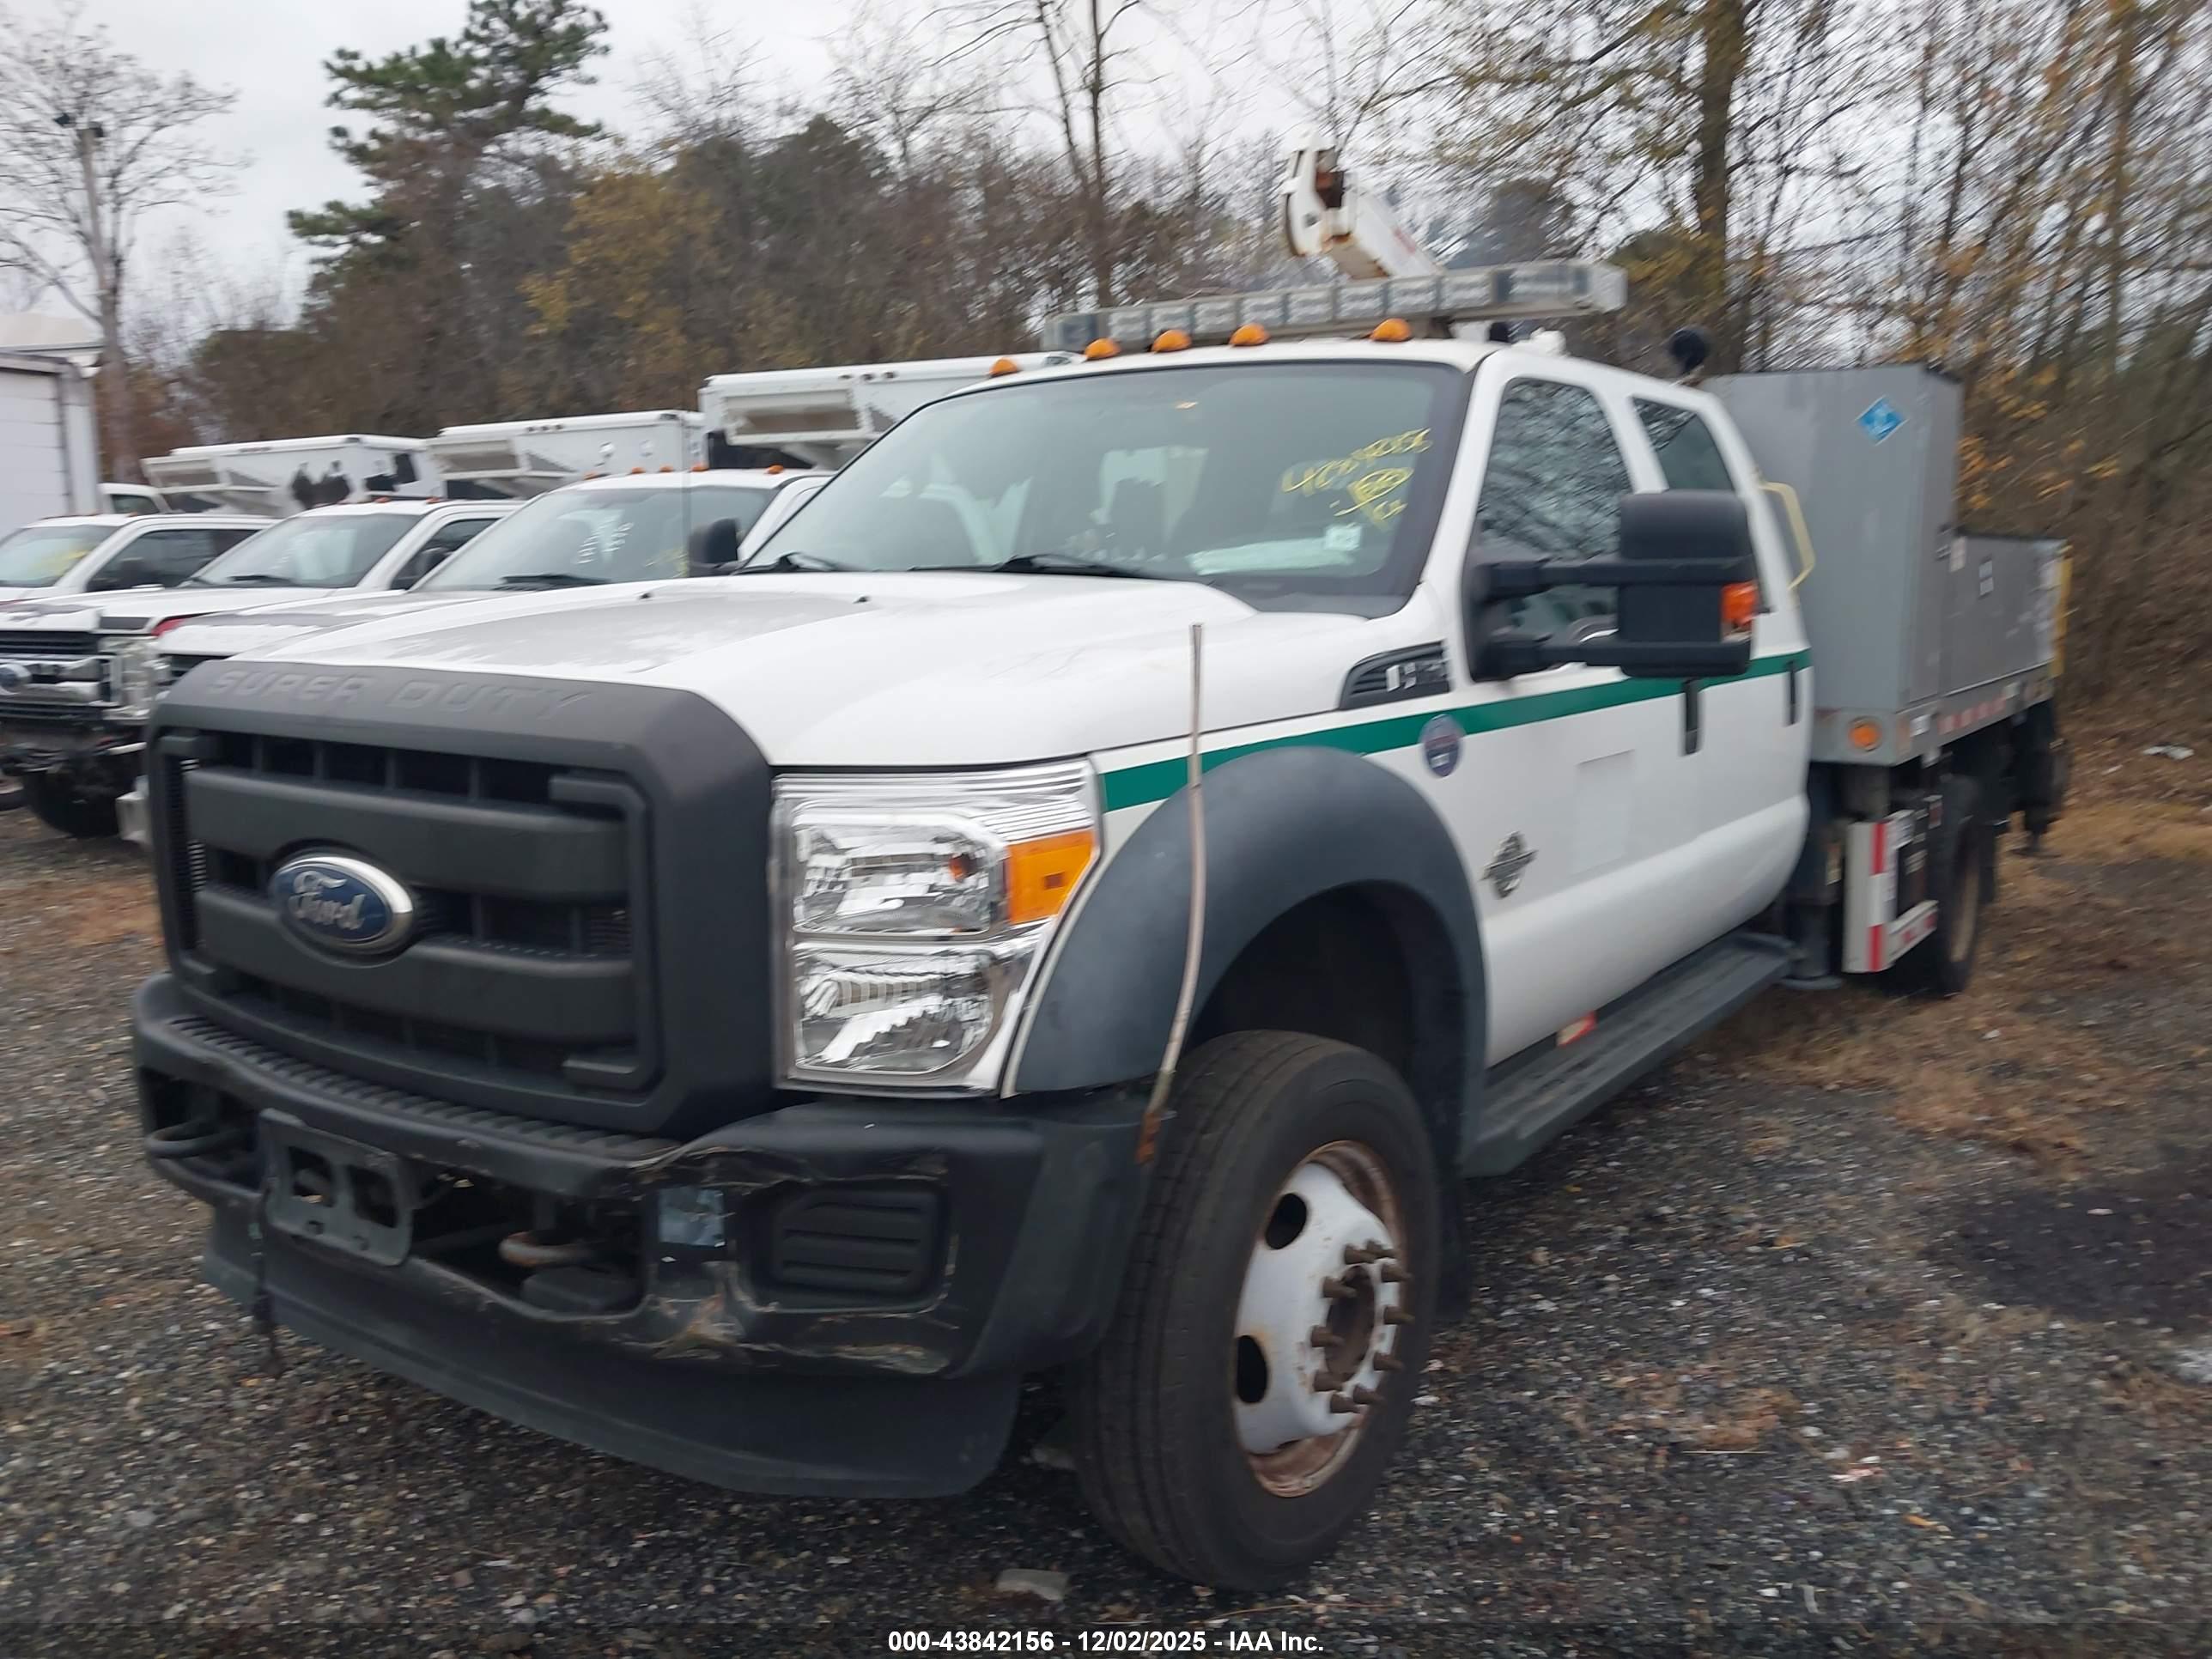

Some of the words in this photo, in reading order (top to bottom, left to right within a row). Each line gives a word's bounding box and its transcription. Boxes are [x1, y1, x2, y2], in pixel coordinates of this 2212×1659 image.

[209, 668, 377, 703] SUPER
[385, 679, 596, 721] DUTY
[289, 870, 368, 931] Ford
